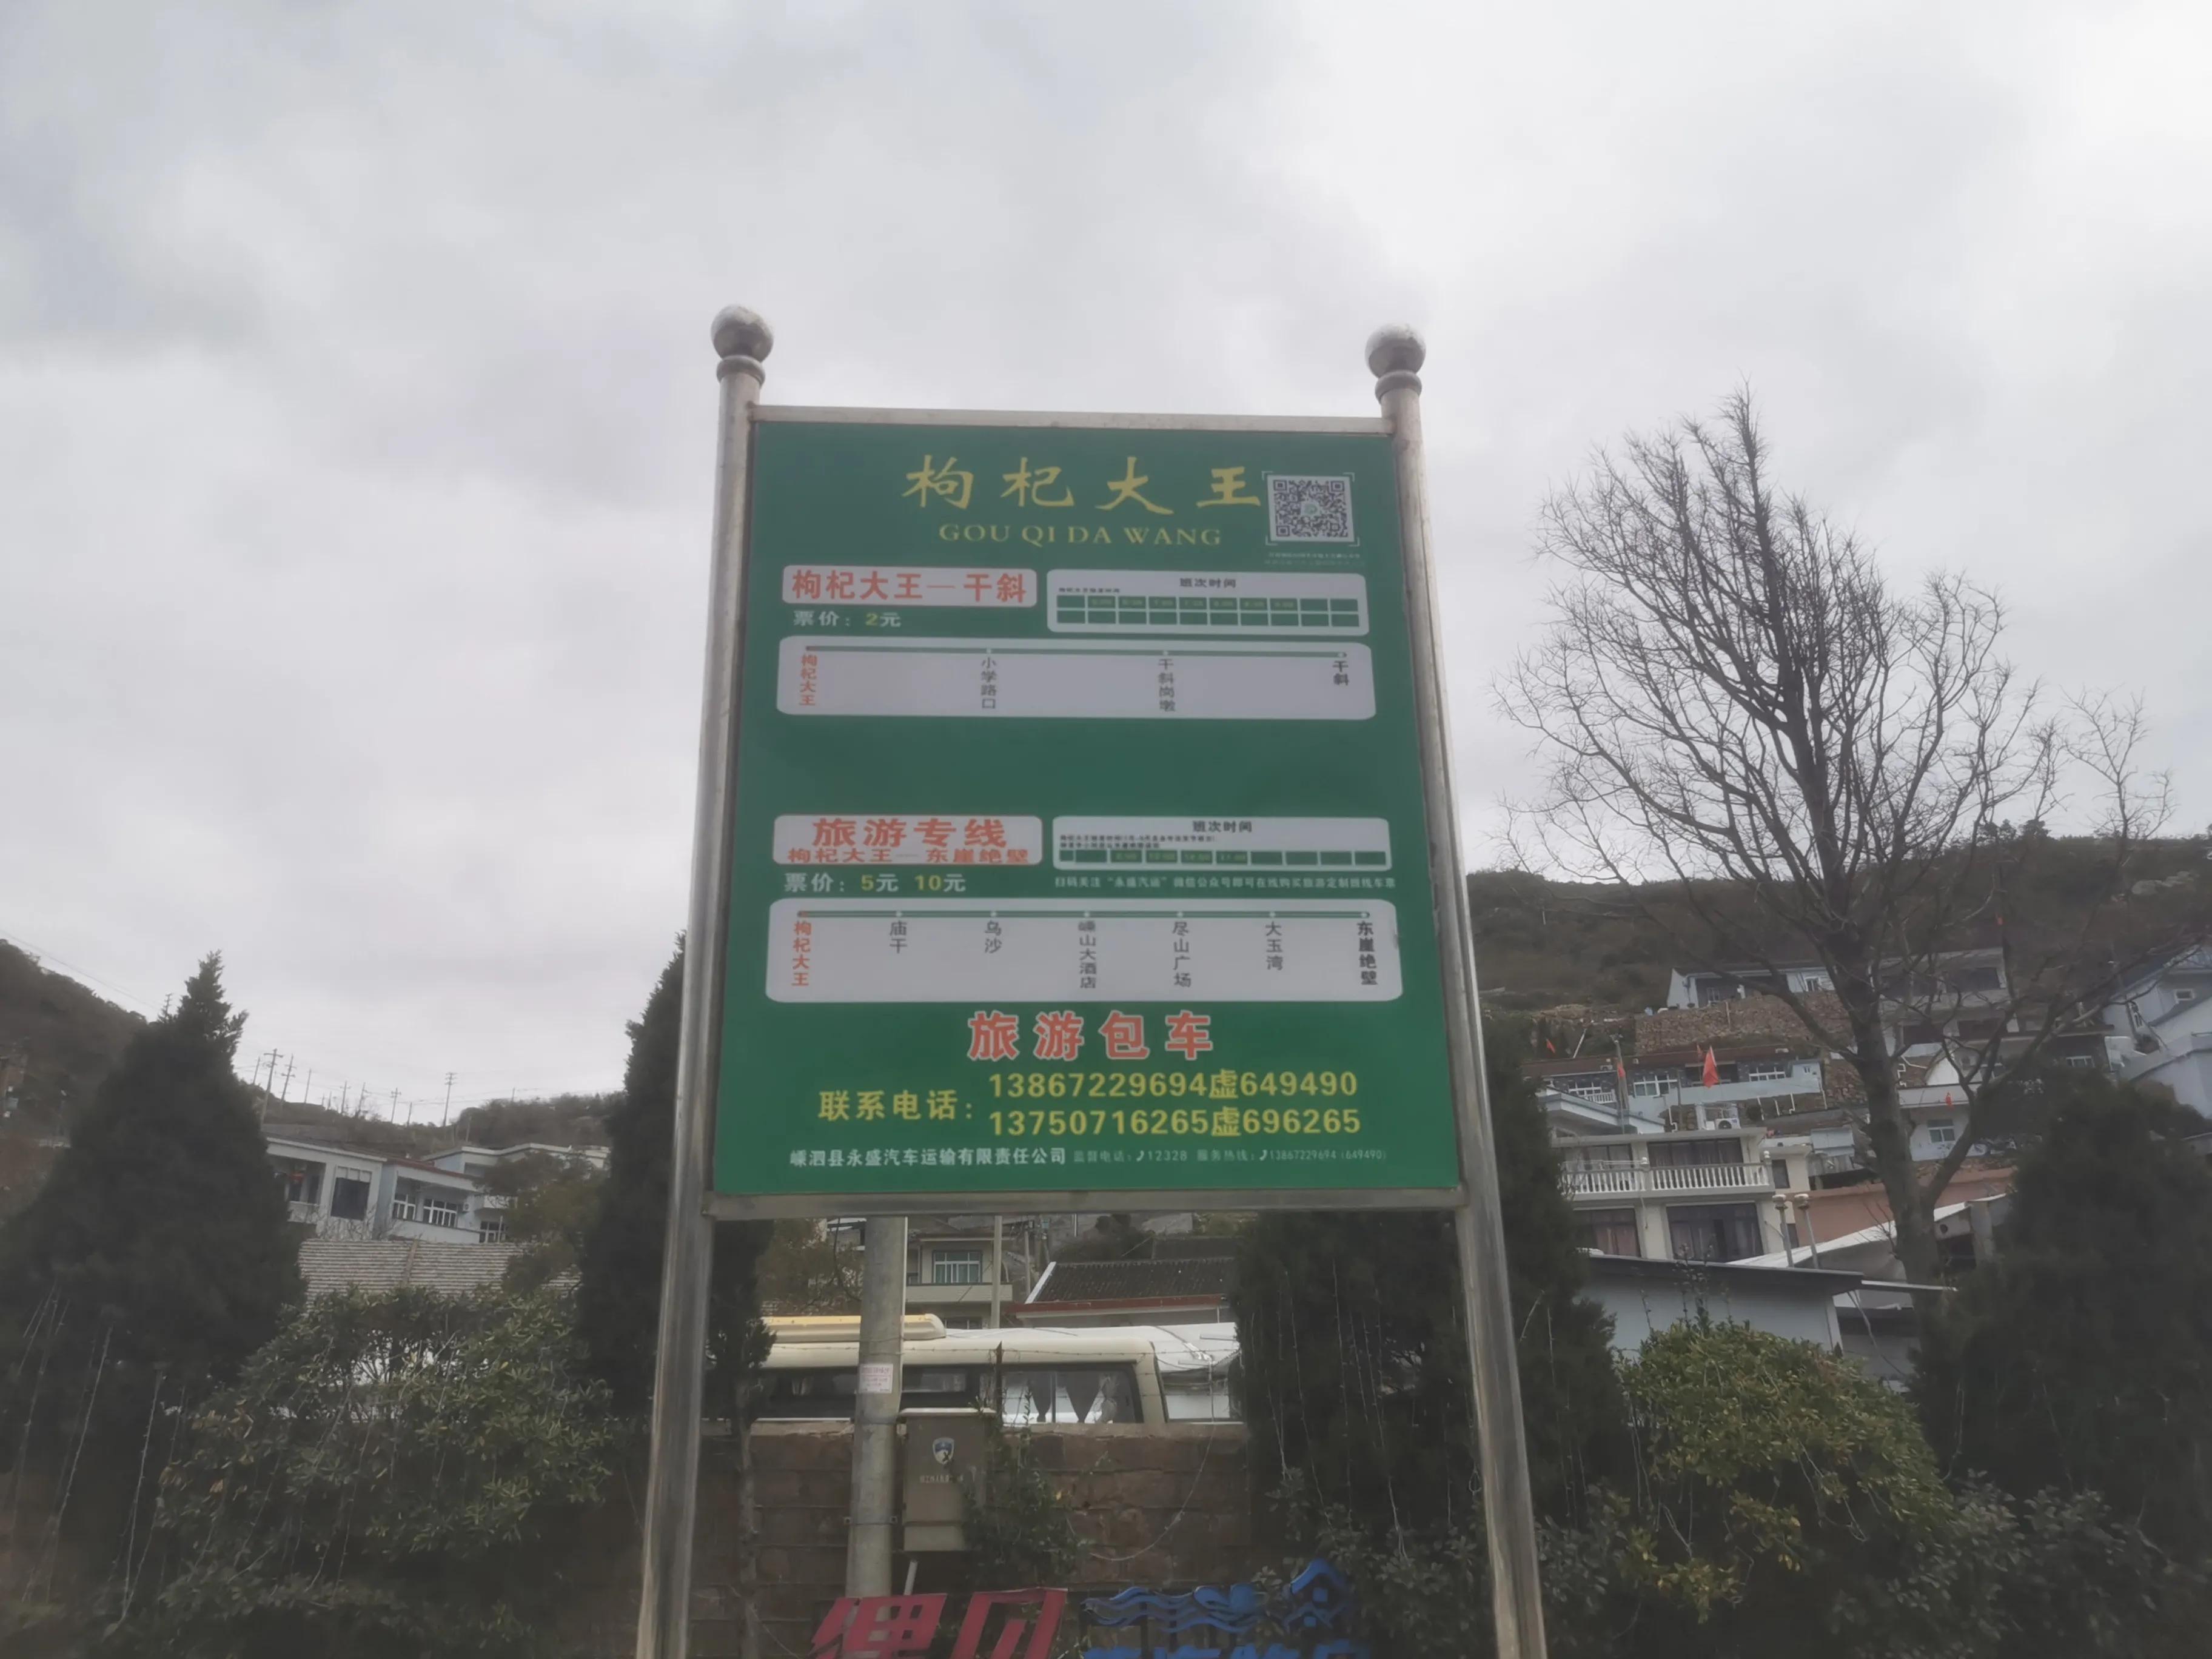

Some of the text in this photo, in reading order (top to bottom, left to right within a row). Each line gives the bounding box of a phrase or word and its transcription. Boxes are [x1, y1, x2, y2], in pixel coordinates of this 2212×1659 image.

[902, 455, 1261, 514] 枸杞大王
[939, 525, 1220, 547] GOU QI DA WANG
[1180, 578, 1236, 588] 班次时间
[800, 654, 817, 706] 枸杞大王
[980, 656, 997, 709] 小学路口
[813, 818, 1007, 847] 旅游专线
[1193, 821, 1252, 833] 班次时间
[915, 874, 966, 892] 10元
[792, 920, 812, 986] 枸杞大王
[985, 919, 1002, 953] 乌沙
[1172, 920, 1191, 987] 尽山广场
[1357, 920, 1377, 985] 东崖绝壁
[968, 1011, 1213, 1061] 旅游包车
[818, 1090, 971, 1121] 联系电话：
